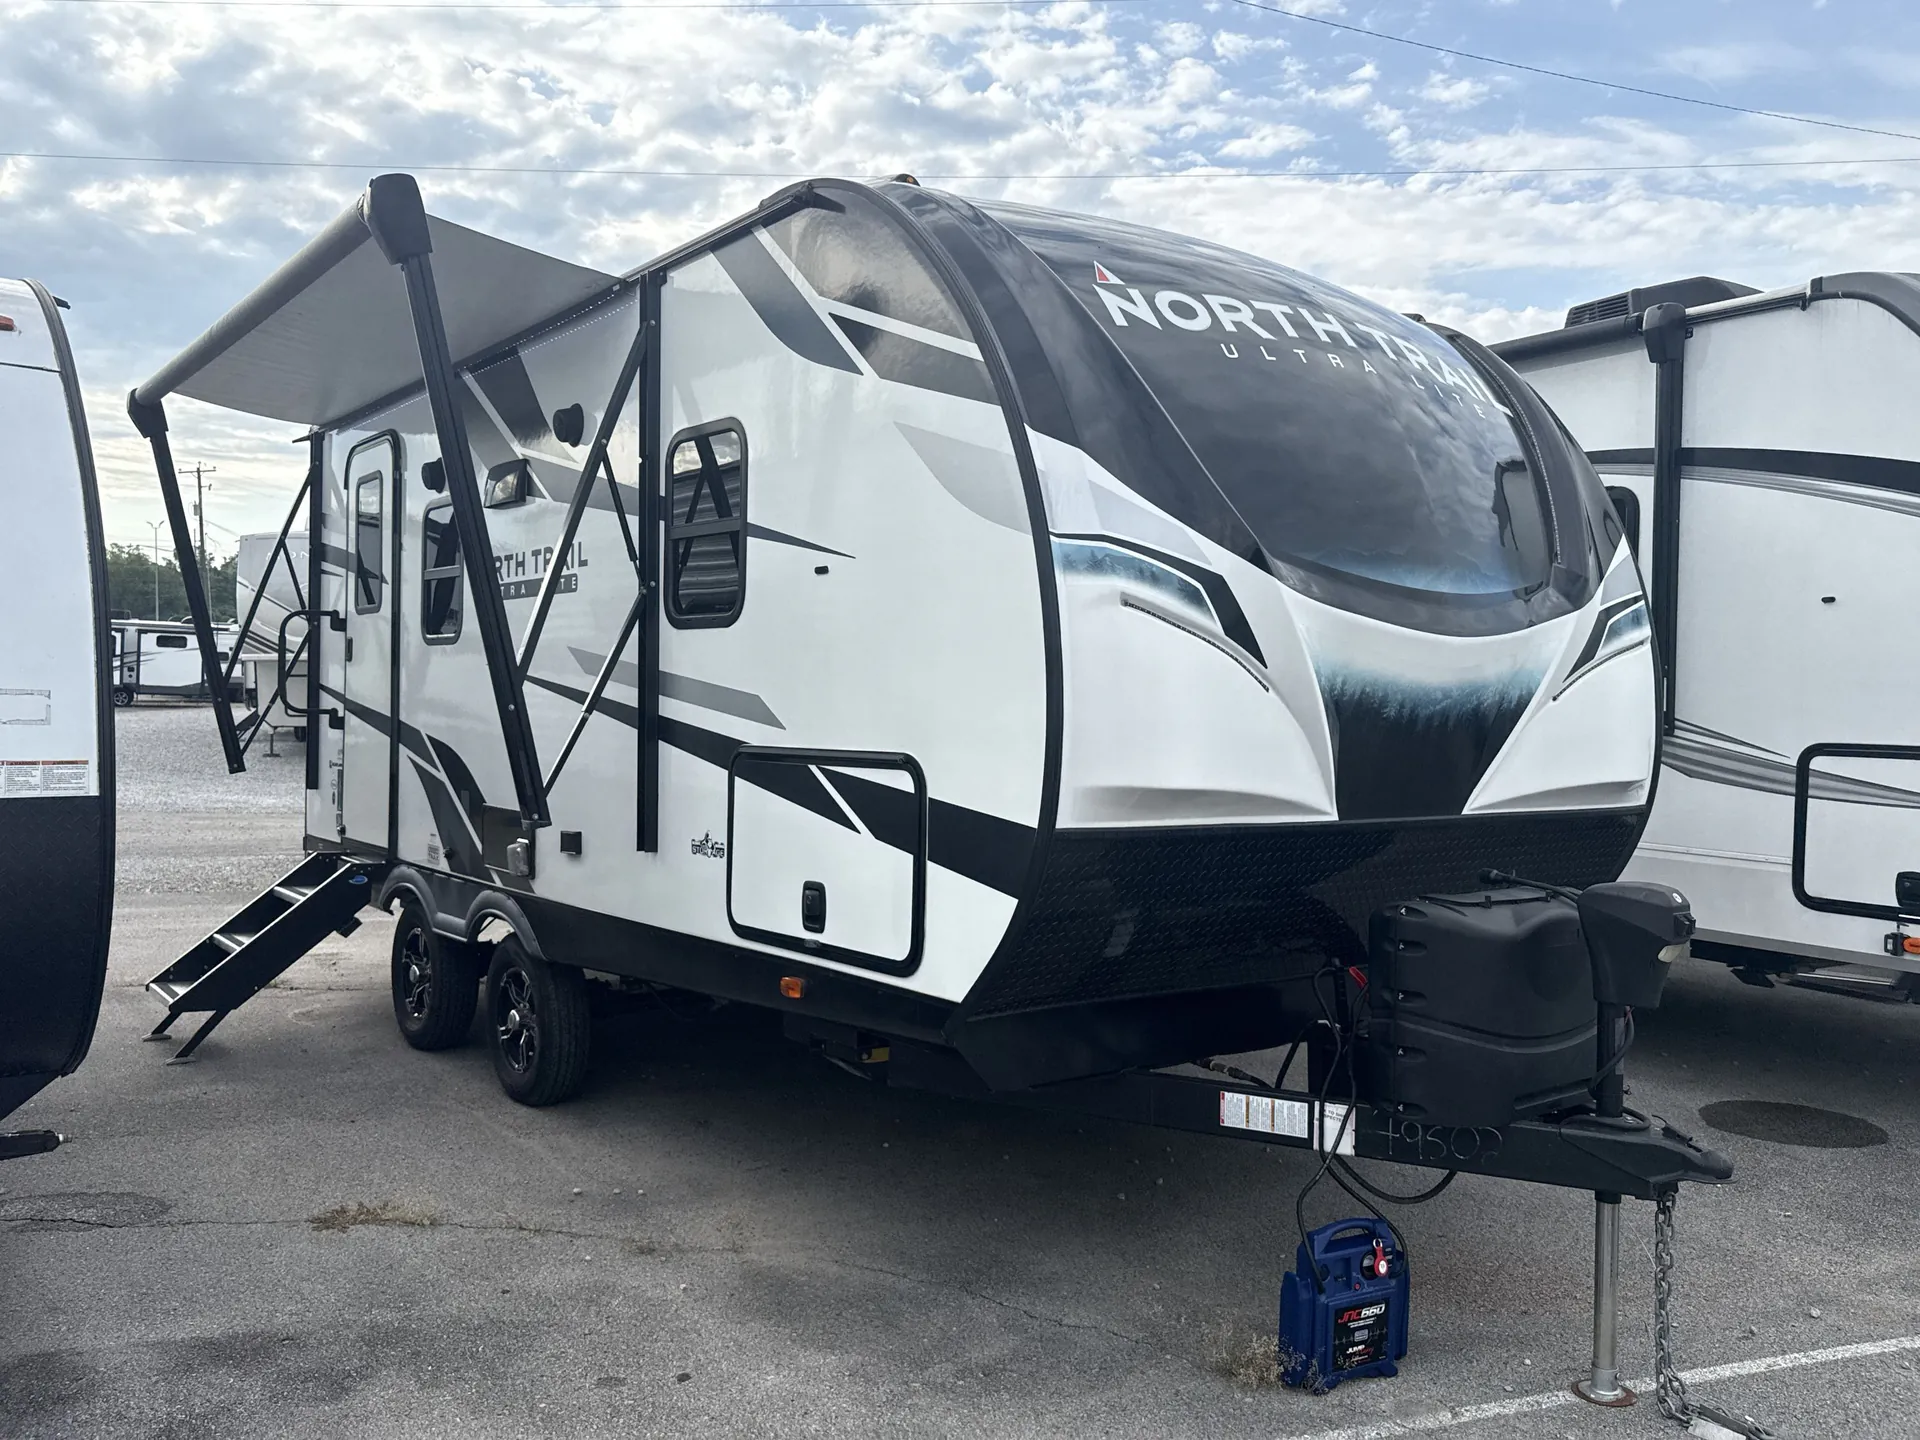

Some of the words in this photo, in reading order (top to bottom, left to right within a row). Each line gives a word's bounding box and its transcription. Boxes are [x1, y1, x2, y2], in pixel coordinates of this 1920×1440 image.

[1092, 283, 1358, 348] NORTH
[1354, 322, 1515, 418] TRAIL
[1221, 343, 1378, 376] ULTRA
[1410, 374, 1486, 419] LITE
[1337, 1303, 1386, 1324] JNC660
[1346, 1344, 1366, 1354] JUMP
